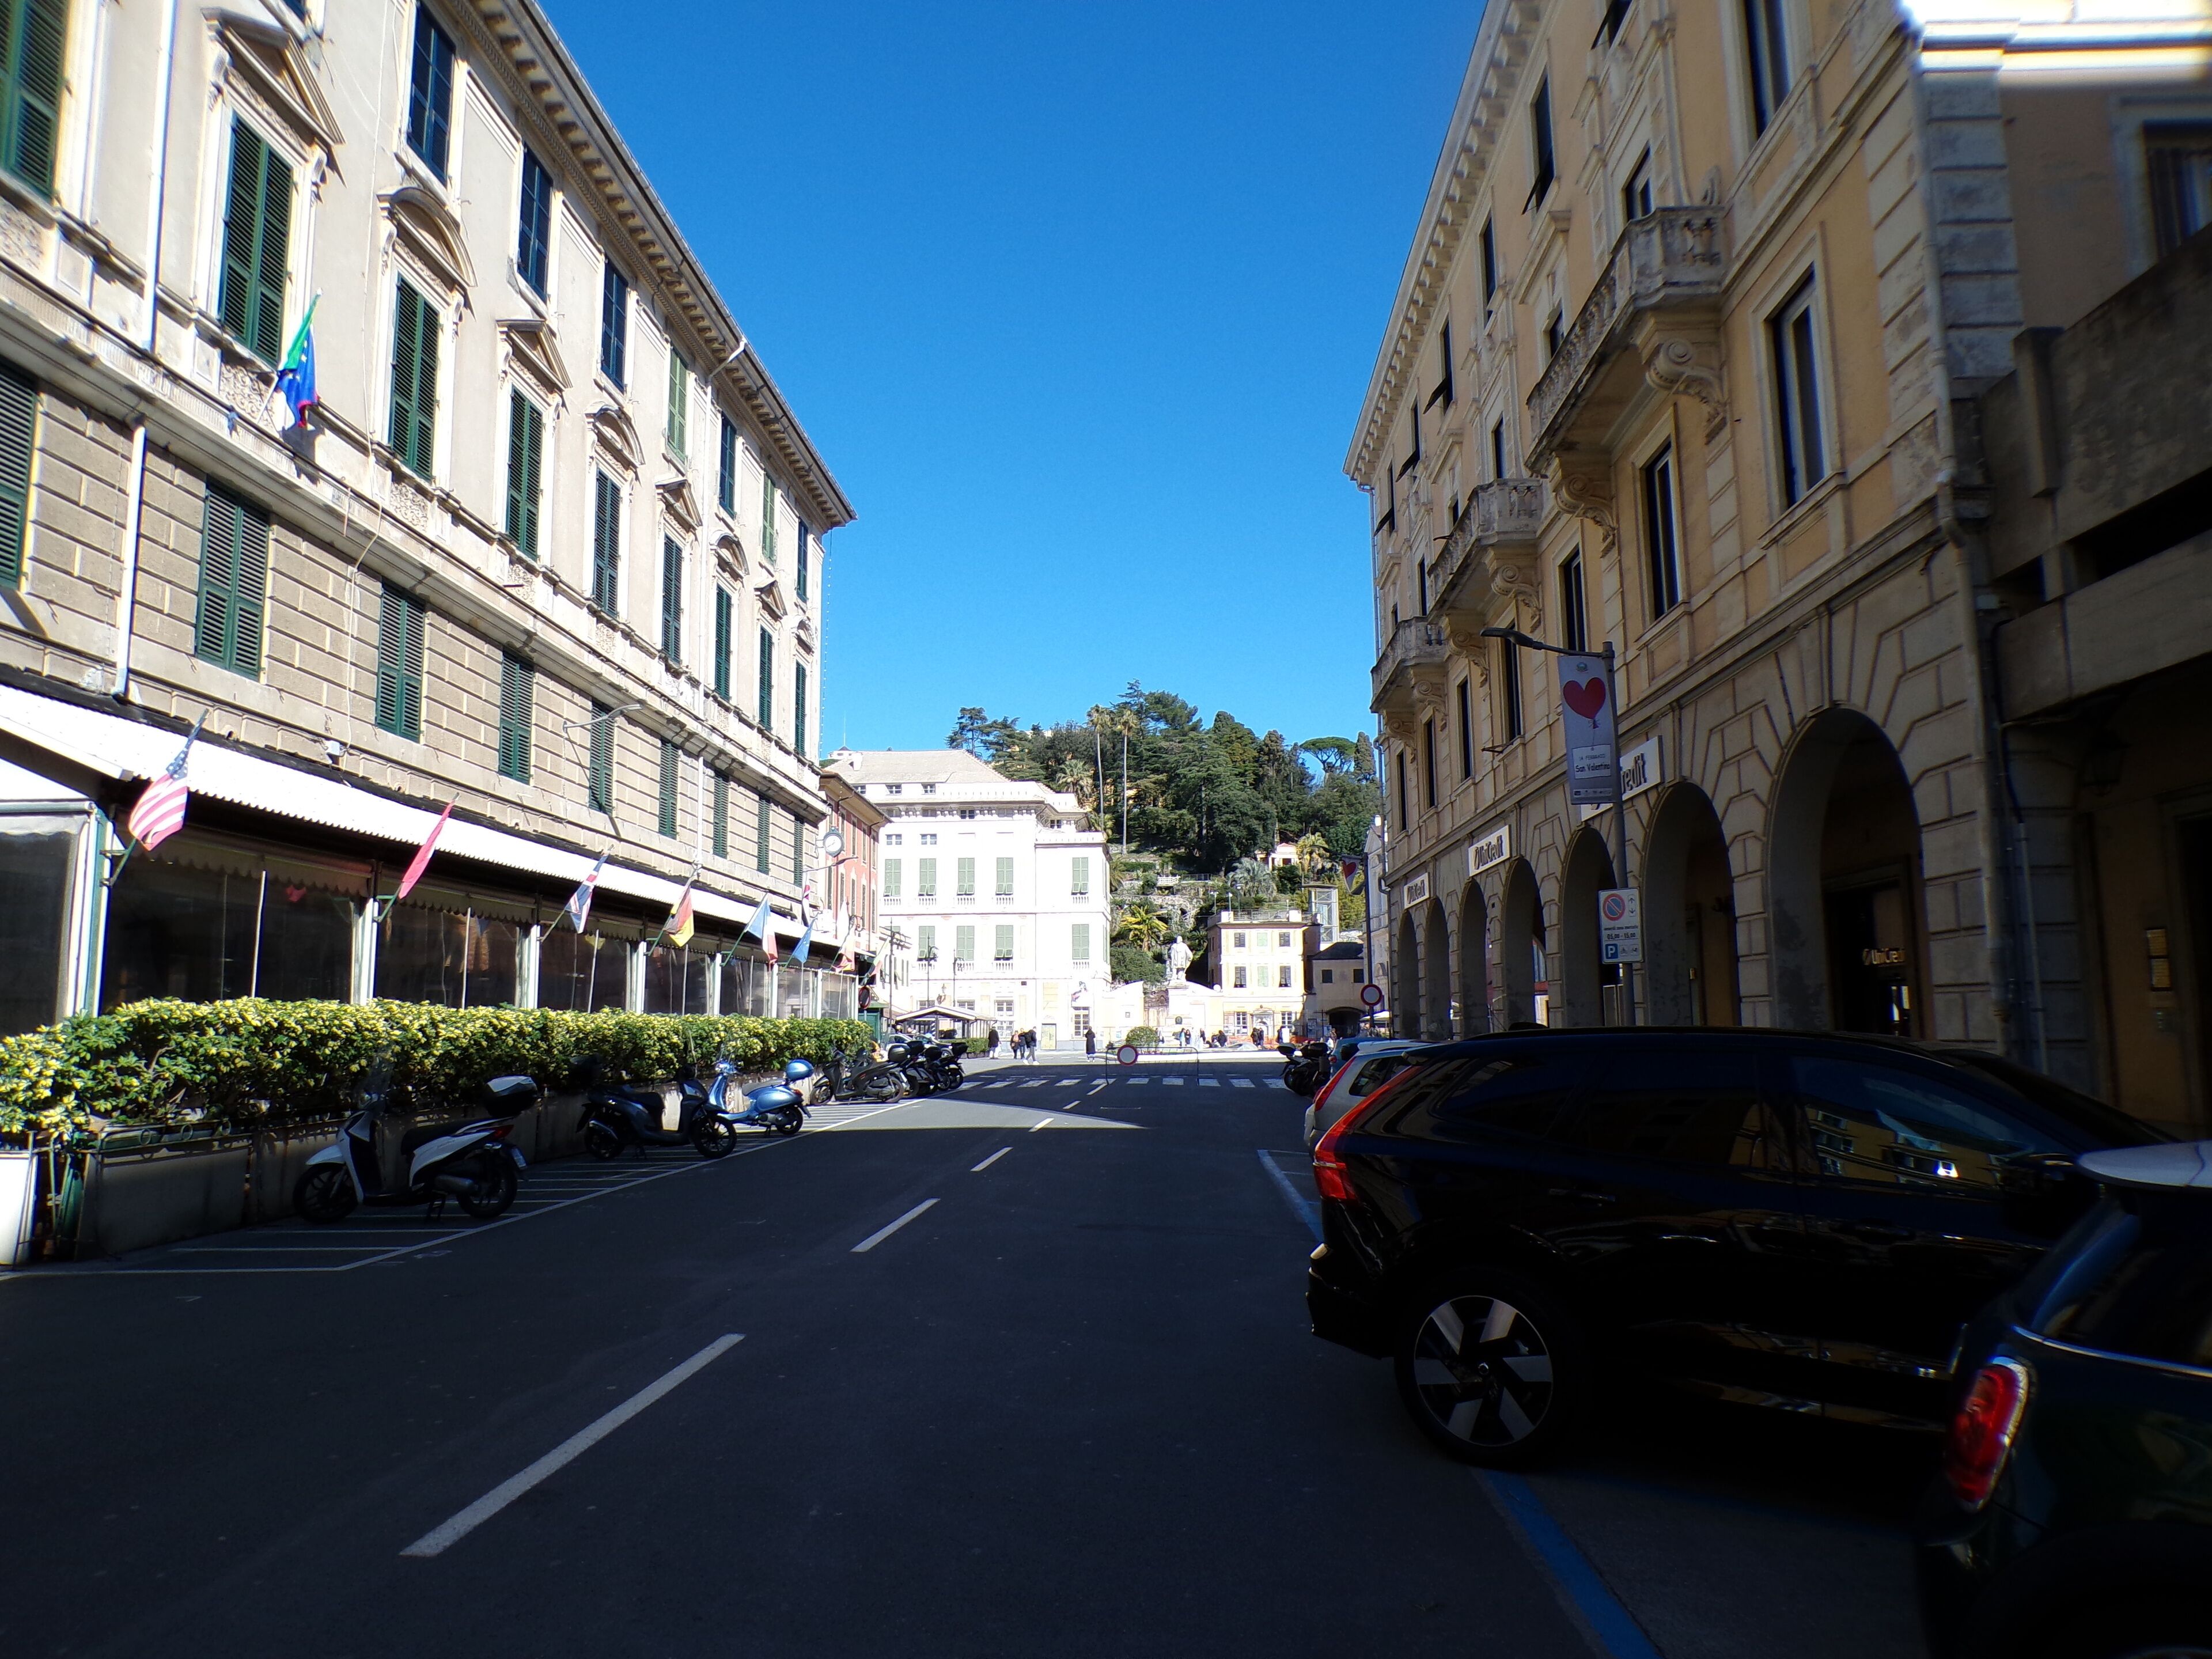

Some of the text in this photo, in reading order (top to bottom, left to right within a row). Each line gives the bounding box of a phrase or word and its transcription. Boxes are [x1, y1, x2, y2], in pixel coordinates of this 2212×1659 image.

[1575, 762, 1611, 772] San Valentino
[1621, 752, 1647, 794] redit
[1479, 834, 1504, 866] UniCredit
[1608, 946, 1615, 957] P
